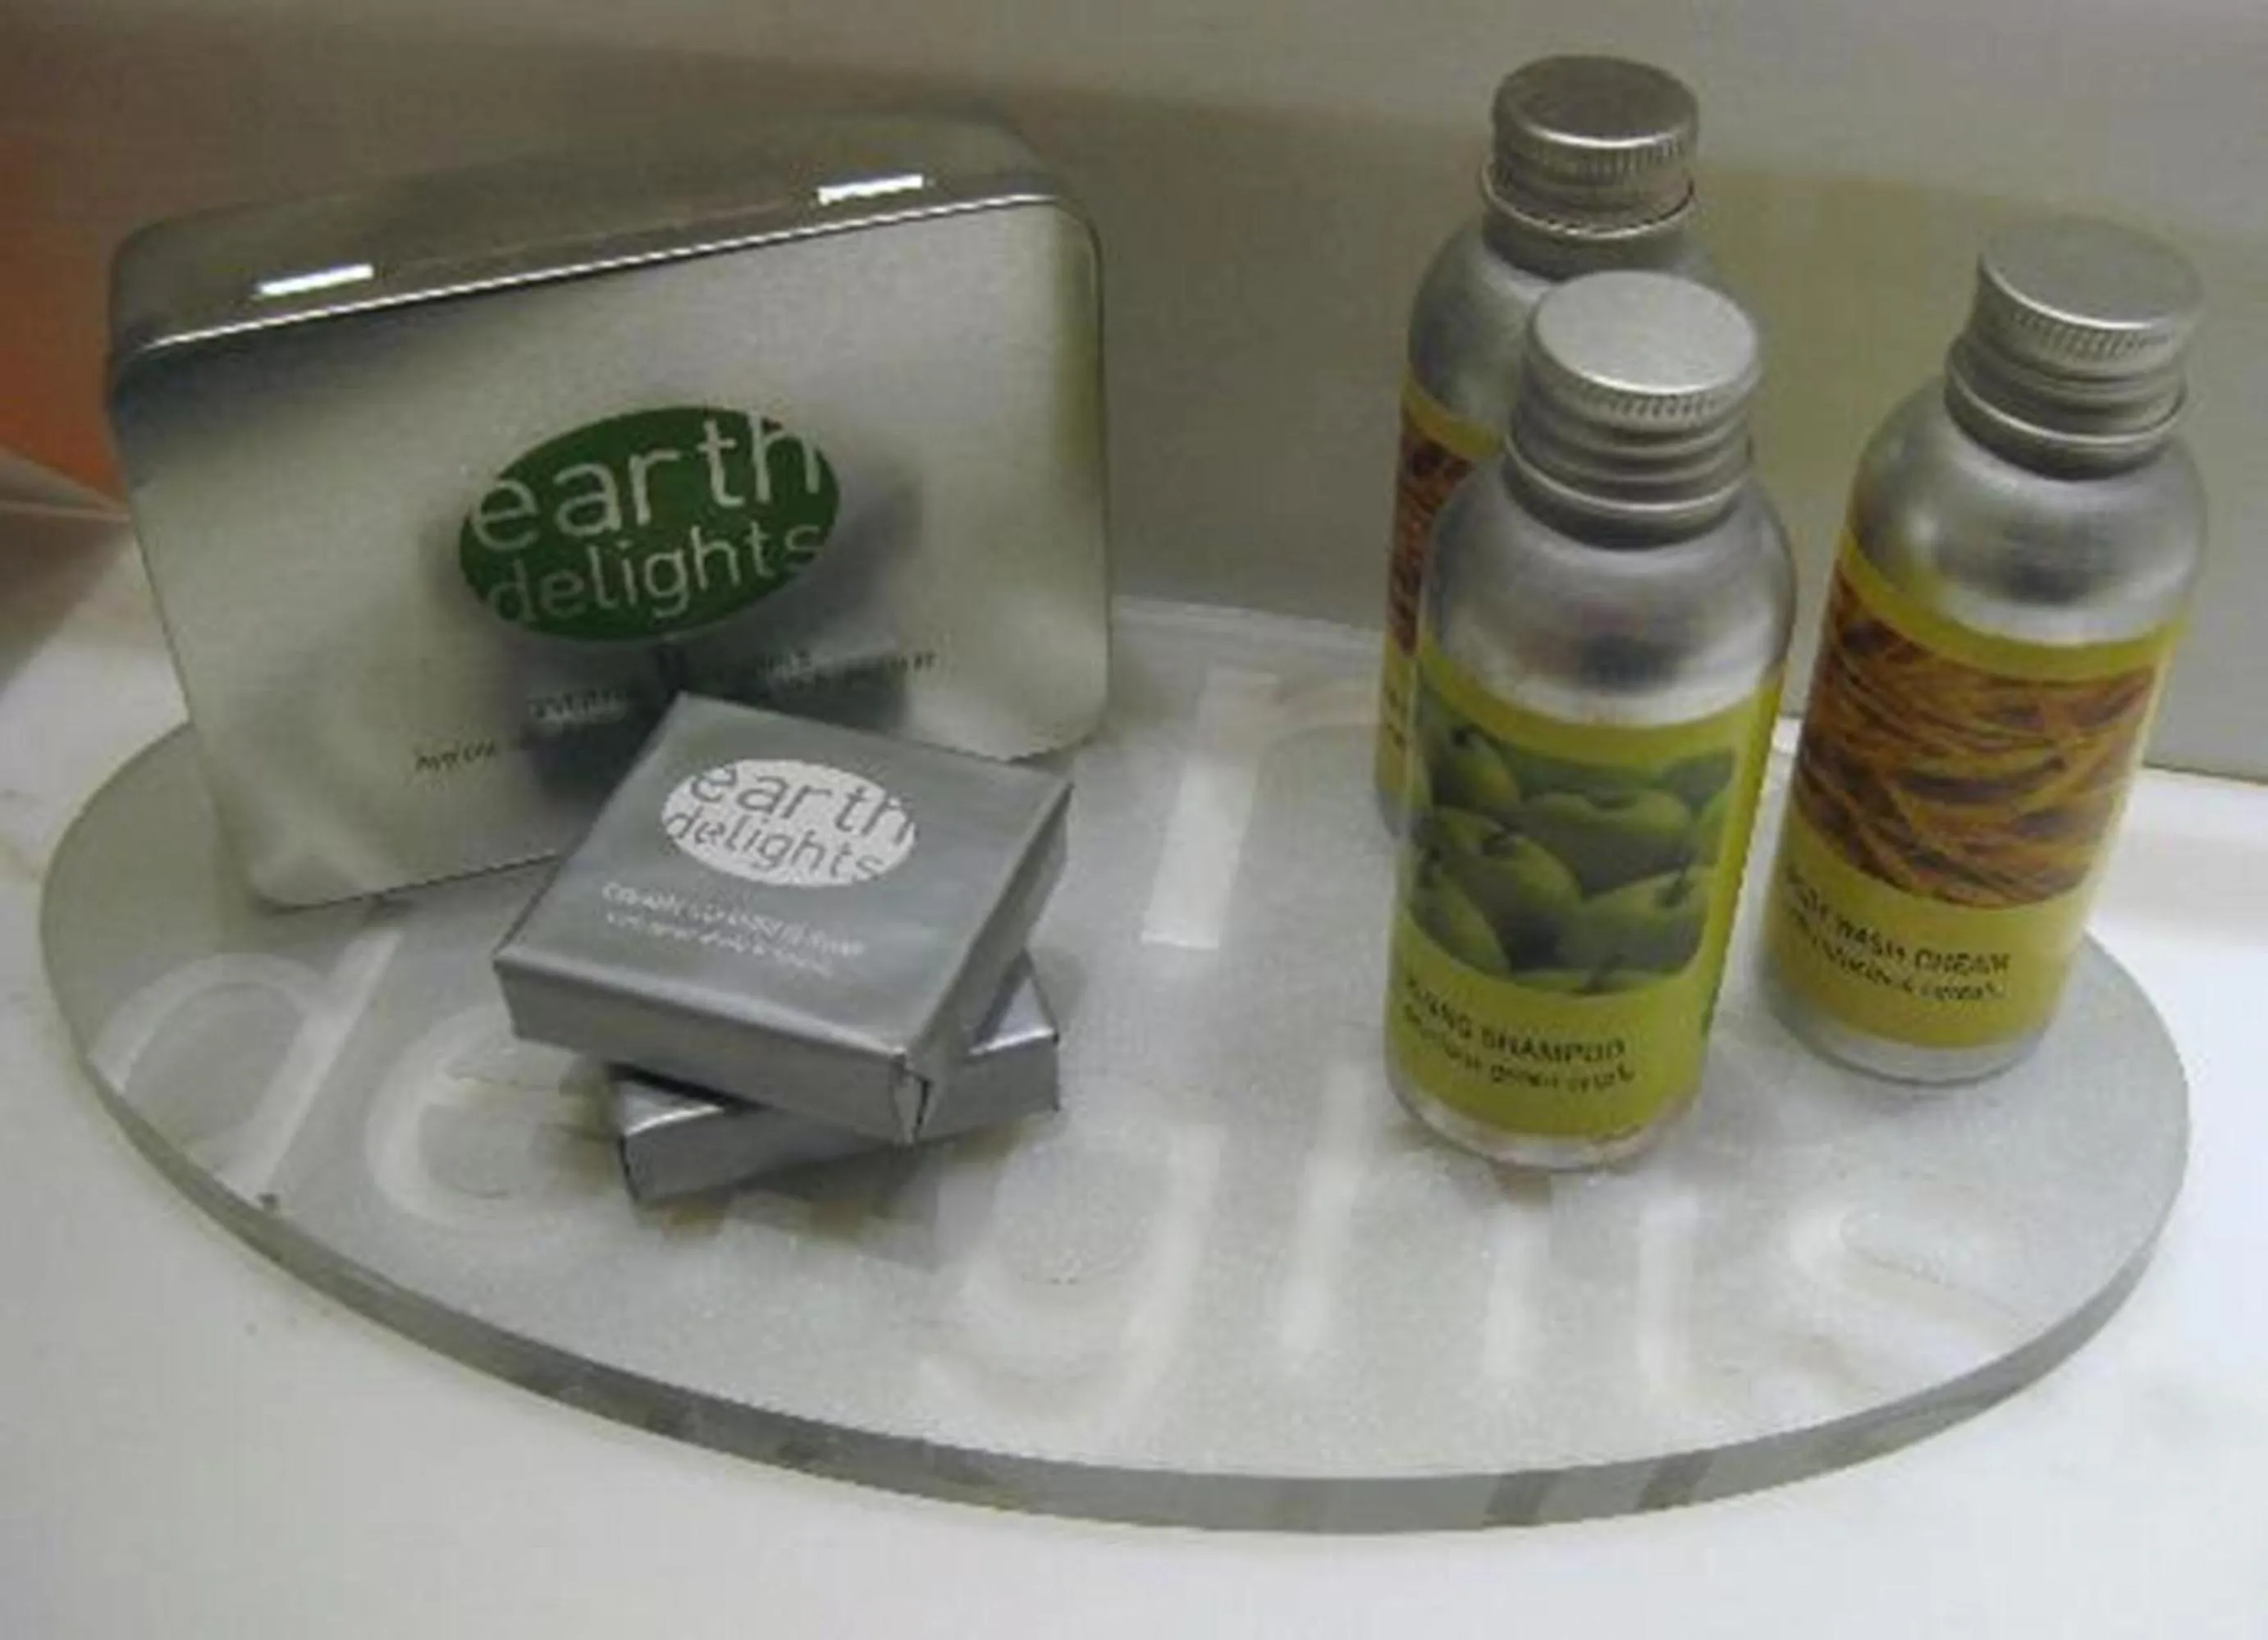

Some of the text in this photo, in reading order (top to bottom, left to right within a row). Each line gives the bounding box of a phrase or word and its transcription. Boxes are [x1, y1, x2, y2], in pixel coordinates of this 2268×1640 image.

[470, 409, 821, 552] earth
[487, 518, 821, 623] delights
[665, 806, 885, 883] delights
[689, 761, 918, 846] earth
[1480, 1027, 1626, 1064] SHAMPOO
